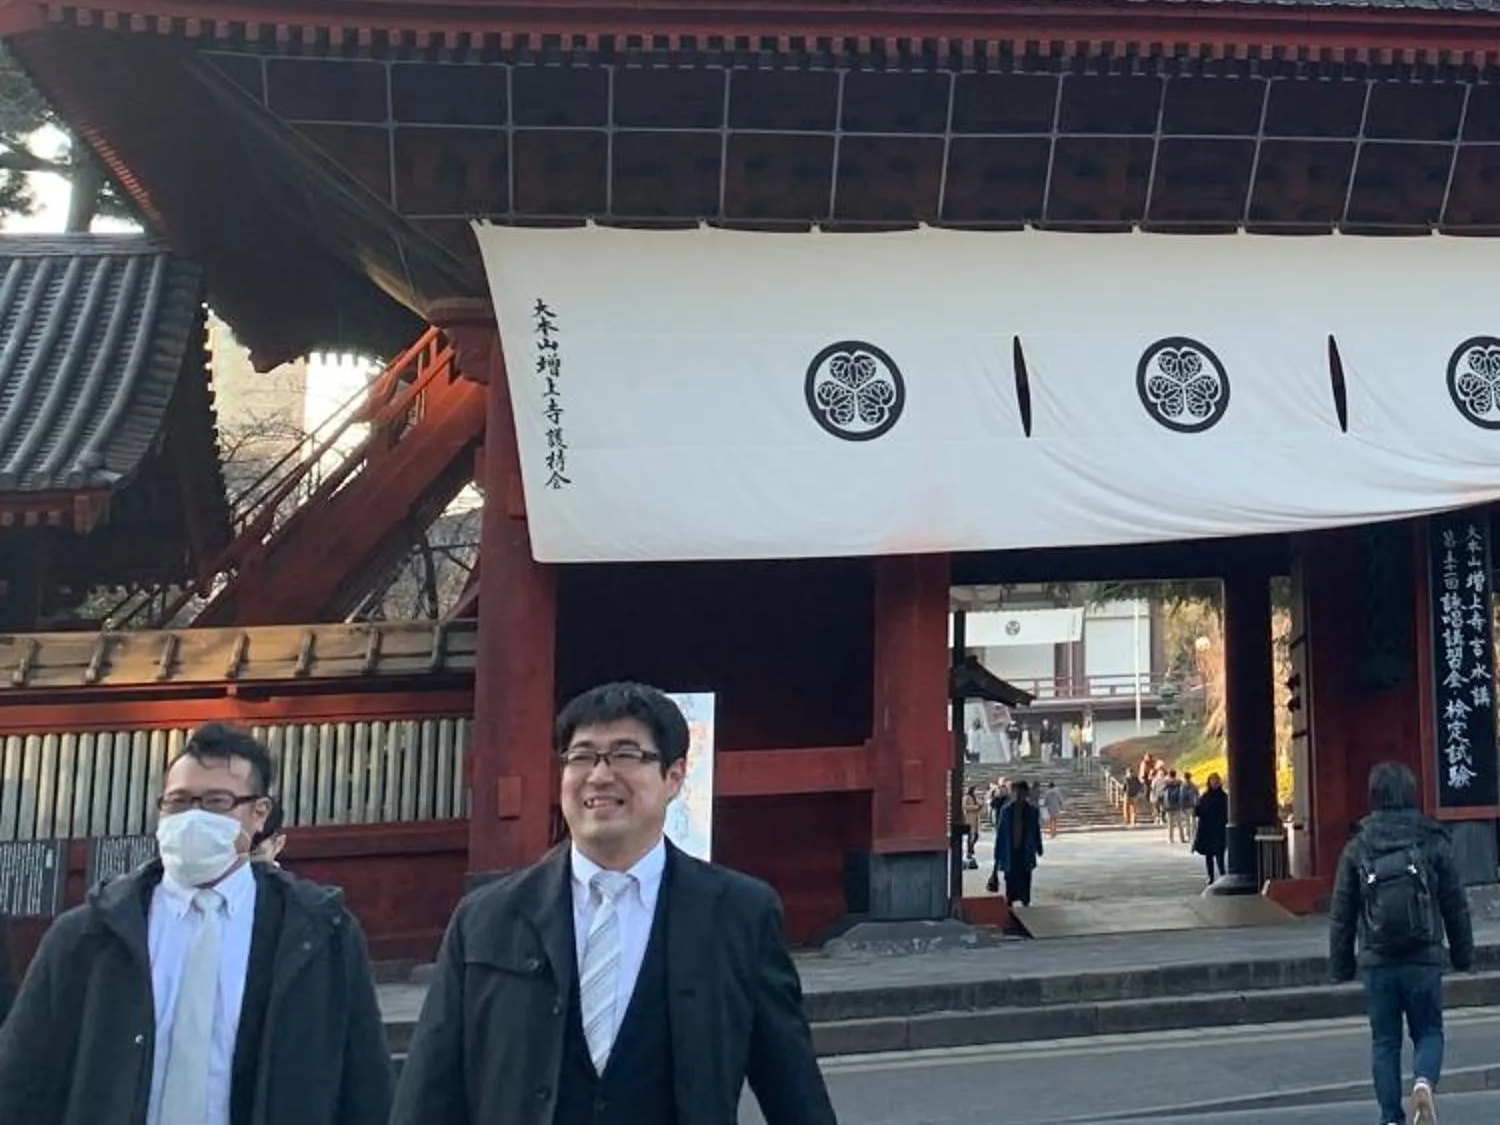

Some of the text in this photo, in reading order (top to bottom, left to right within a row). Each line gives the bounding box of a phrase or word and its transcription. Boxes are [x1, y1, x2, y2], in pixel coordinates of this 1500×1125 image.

[533, 298, 572, 489] 大本山増上寺護持会
